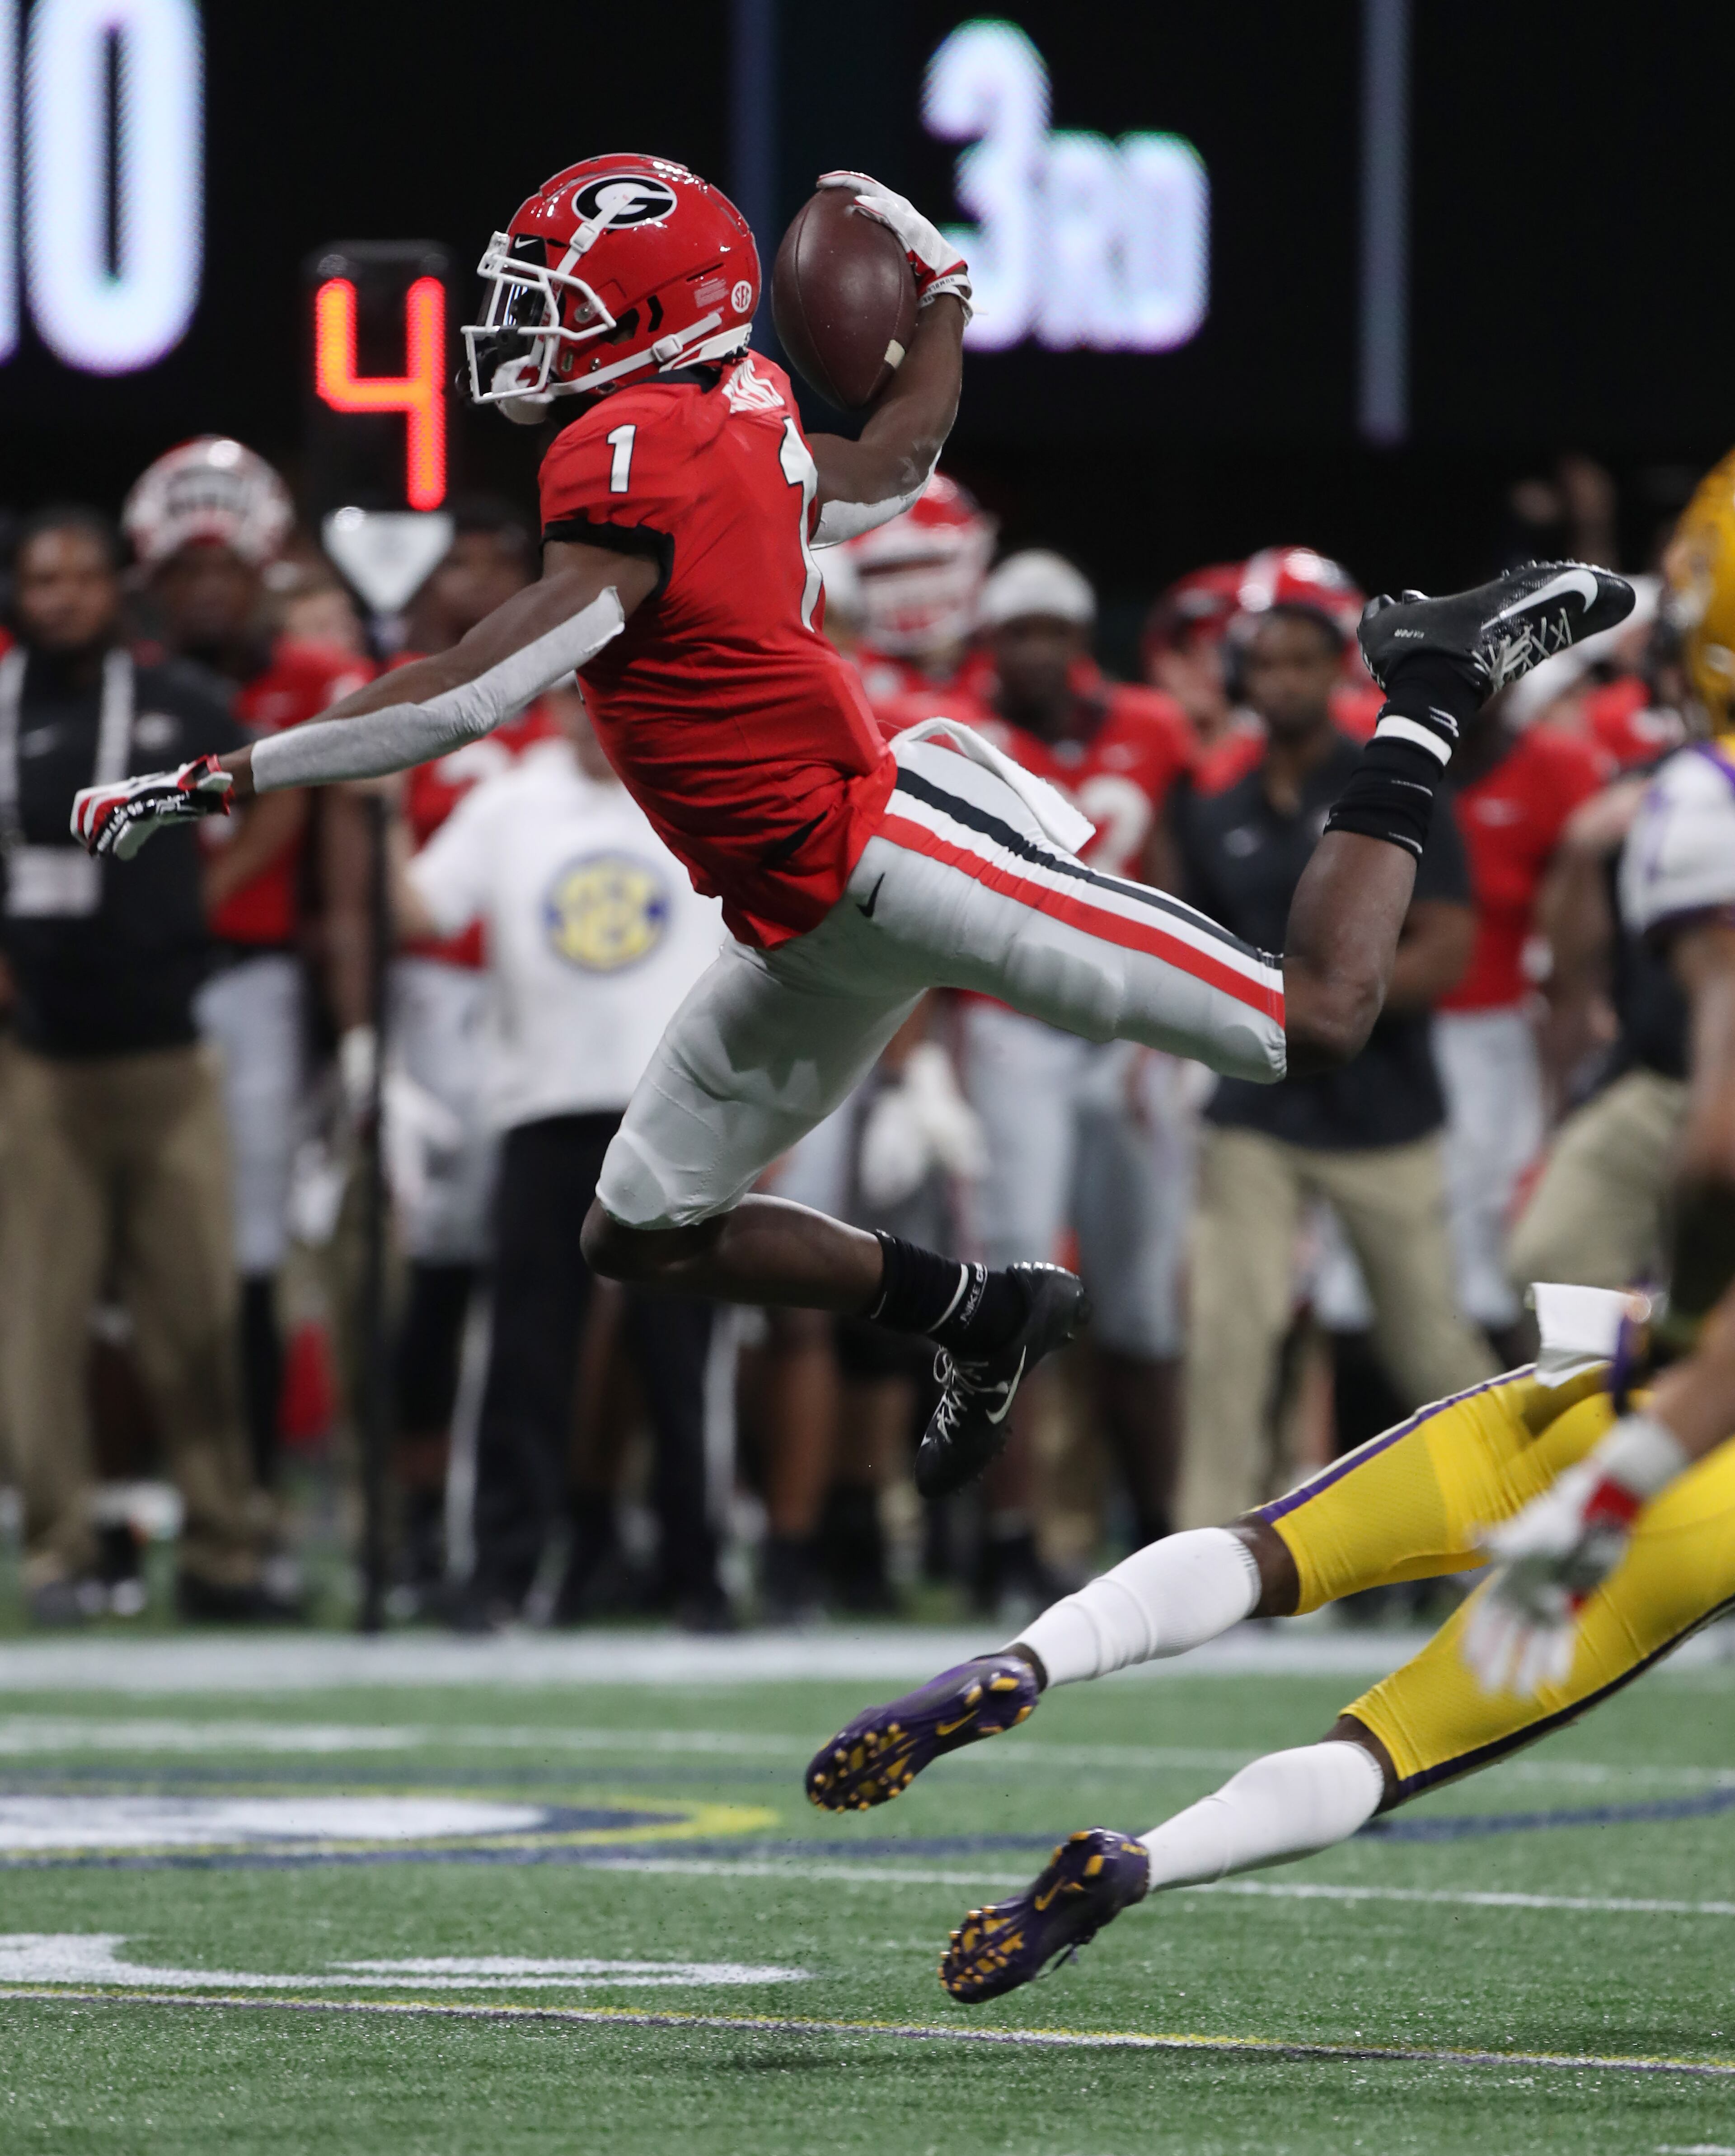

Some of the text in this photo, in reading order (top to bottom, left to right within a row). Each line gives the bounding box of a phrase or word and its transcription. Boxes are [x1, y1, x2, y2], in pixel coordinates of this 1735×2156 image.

[0, 0, 206, 376] 0
[572, 173, 677, 229] G
[315, 277, 447, 511] 4
[607, 424, 637, 493] 1
